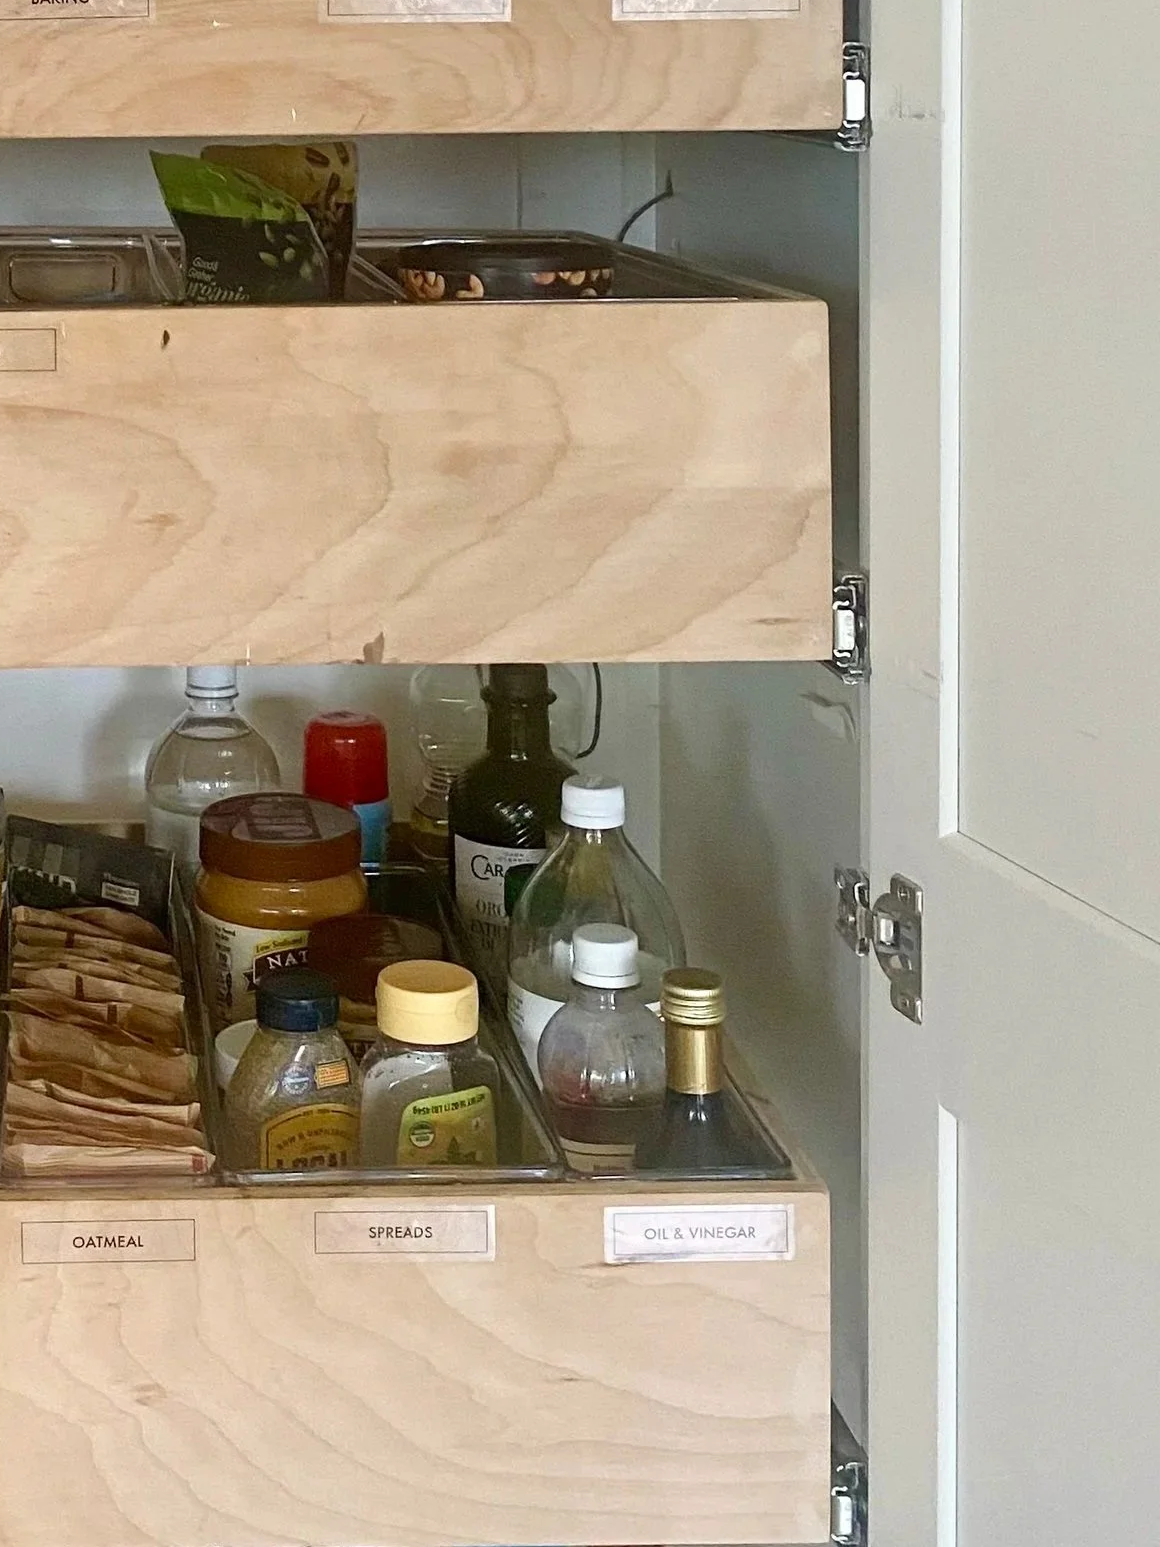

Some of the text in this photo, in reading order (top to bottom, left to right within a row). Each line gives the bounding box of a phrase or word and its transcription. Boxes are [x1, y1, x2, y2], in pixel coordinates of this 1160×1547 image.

[471, 855, 504, 880] CAR
[267, 950, 308, 969] NAT
[369, 1226, 433, 1239] SPREADS
[644, 1226, 756, 1241] OIL & VINEGAR
[72, 1235, 144, 1249] OATMEAL
